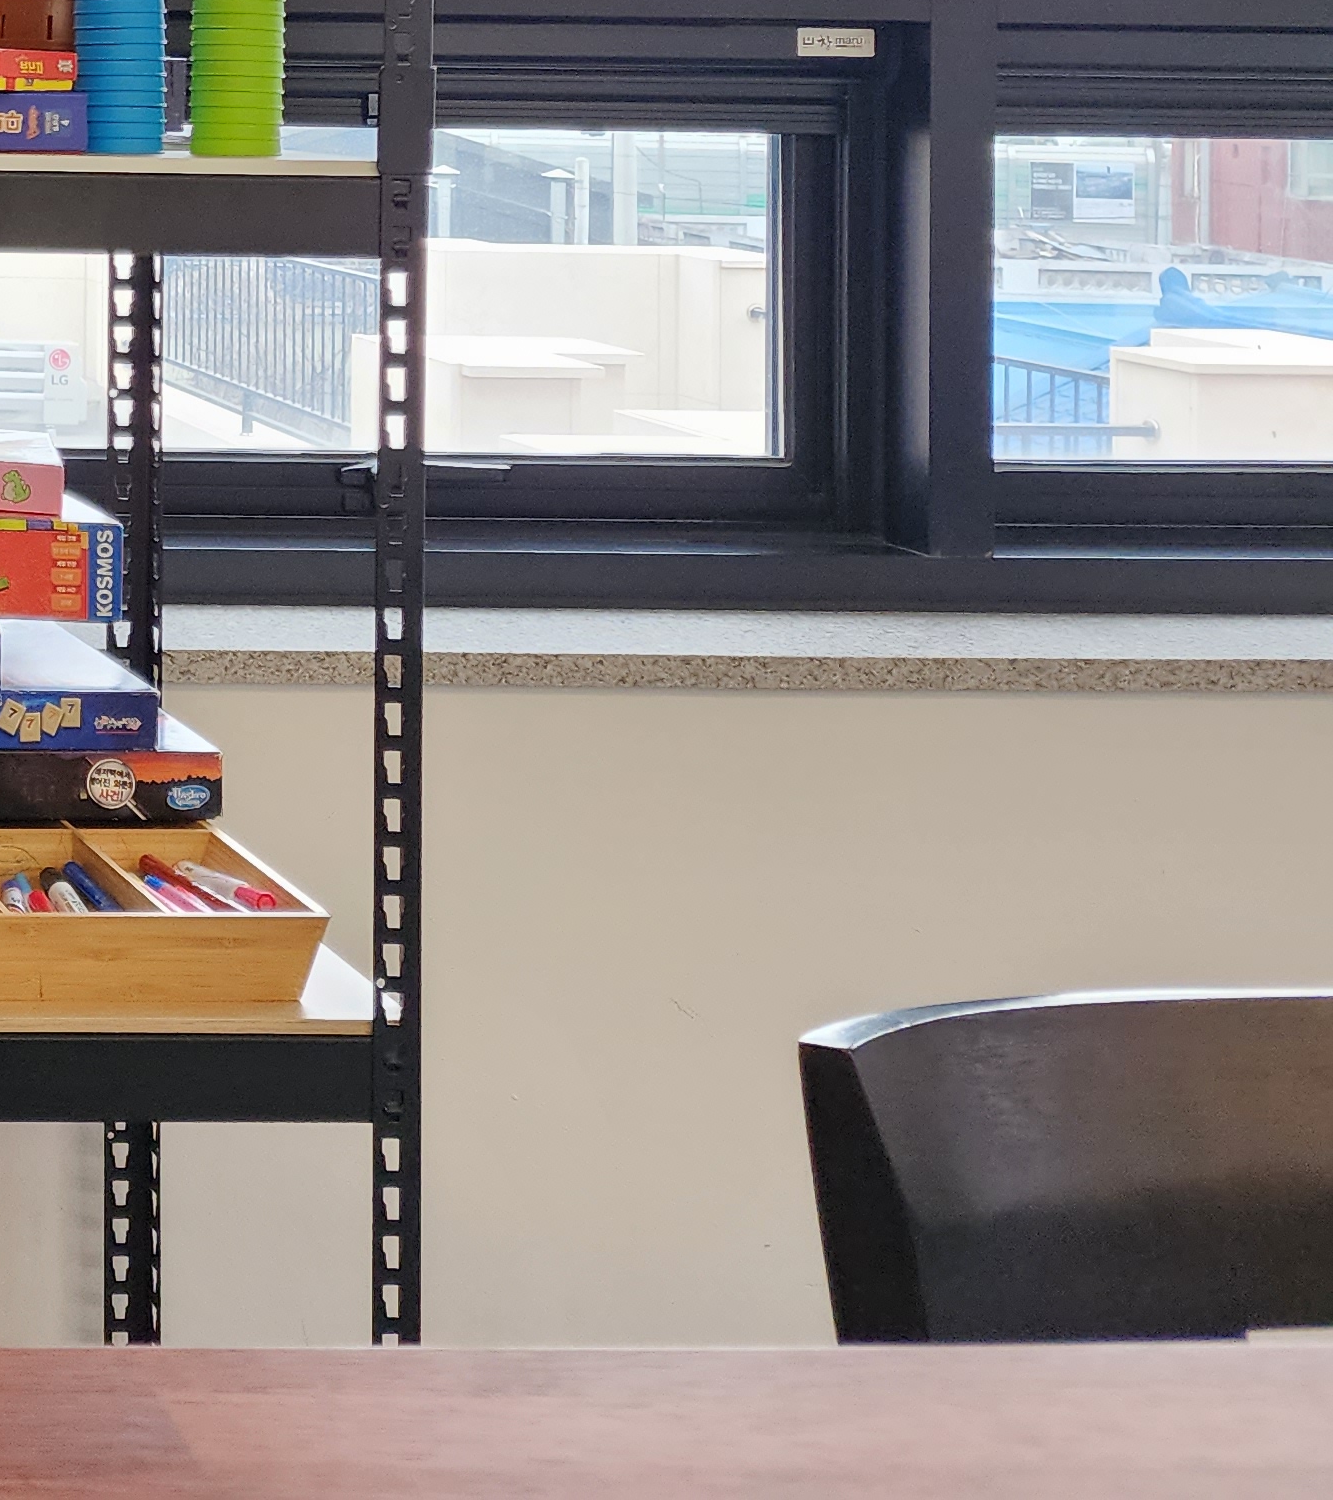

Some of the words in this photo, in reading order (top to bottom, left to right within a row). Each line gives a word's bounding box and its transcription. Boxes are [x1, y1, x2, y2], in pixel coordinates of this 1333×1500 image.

[51, 374, 69, 386] LG
[96, 530, 114, 617] KOSMOS
[8, 707, 18, 719] 7
[68, 703, 75, 714] 7
[25, 718, 35, 729] 7
